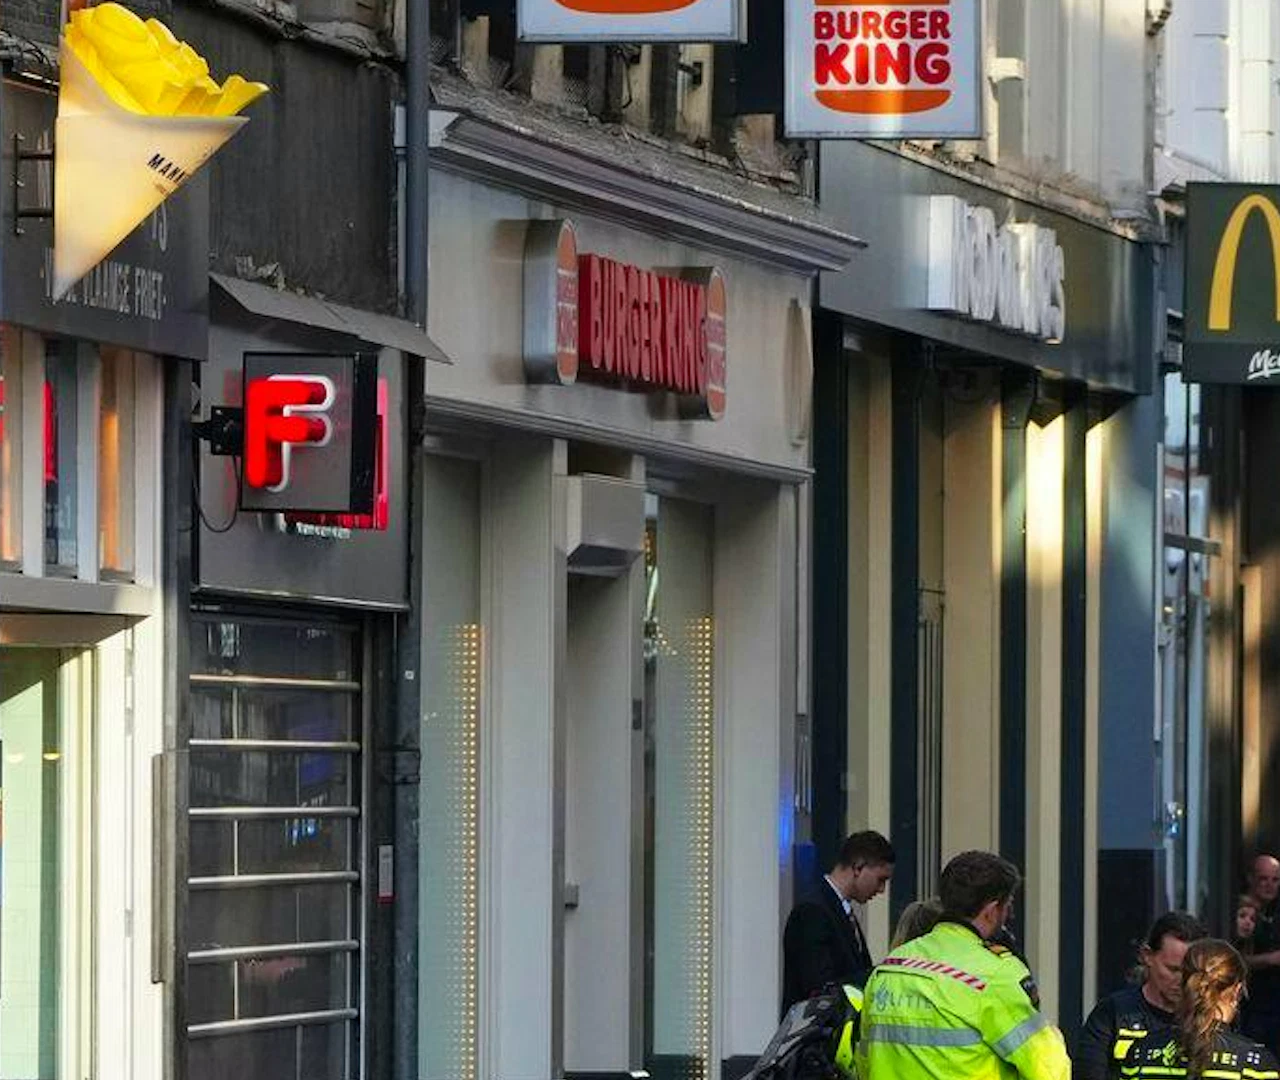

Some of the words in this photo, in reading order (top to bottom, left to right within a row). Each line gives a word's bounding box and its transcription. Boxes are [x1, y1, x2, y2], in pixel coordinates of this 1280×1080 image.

[814, 11, 951, 40] BURGER
[815, 43, 951, 85] KING
[590, 254, 664, 384] BURGER
[665, 275, 709, 397] KING
